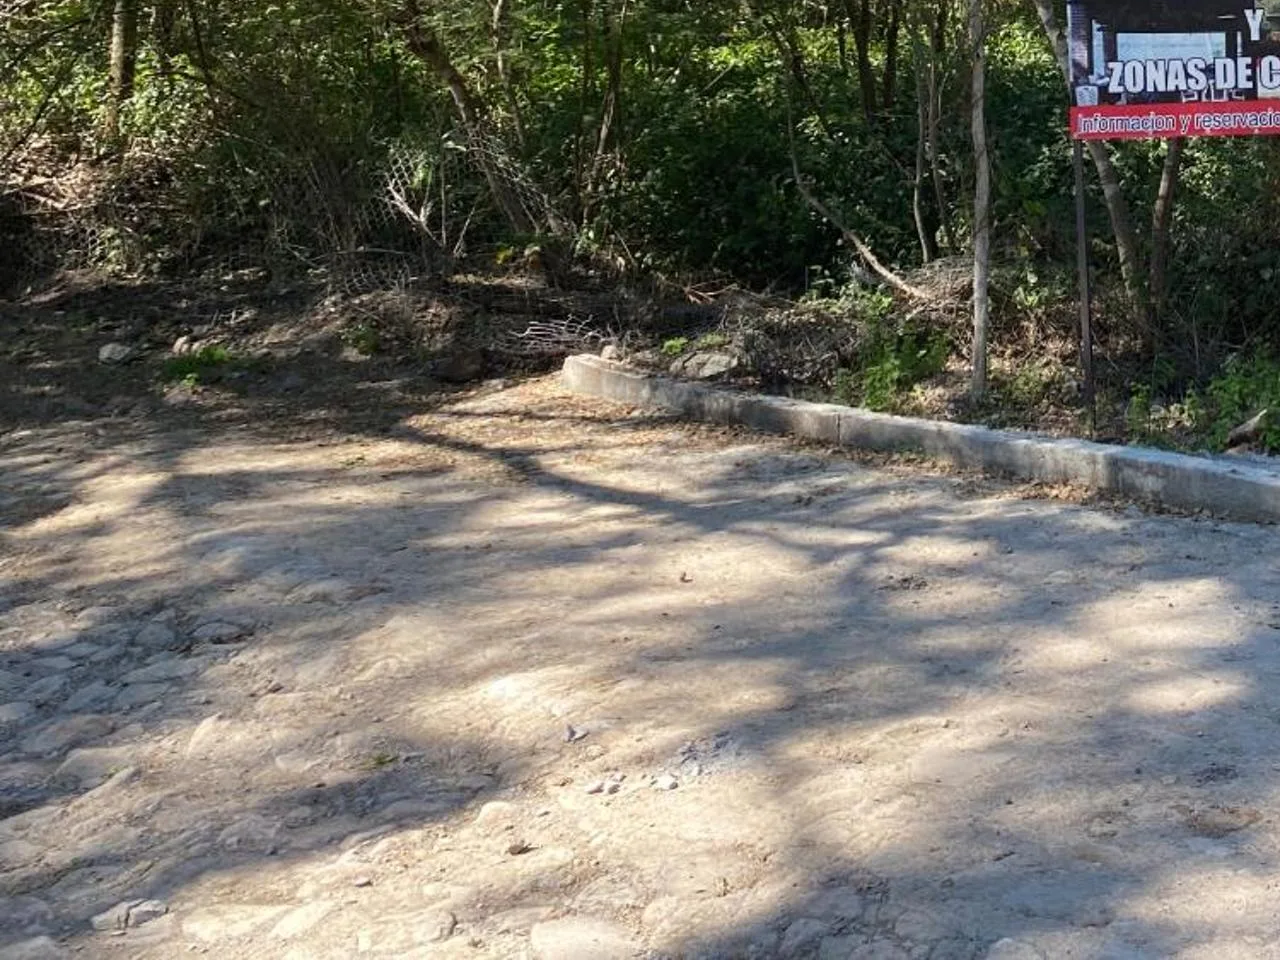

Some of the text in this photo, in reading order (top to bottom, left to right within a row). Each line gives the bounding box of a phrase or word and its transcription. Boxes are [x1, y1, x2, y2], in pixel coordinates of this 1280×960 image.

[1243, 8, 1264, 40] Y
[1107, 61, 1208, 94] ZONAS
[1215, 58, 1253, 90] DE
[1179, 114, 1191, 134] y
